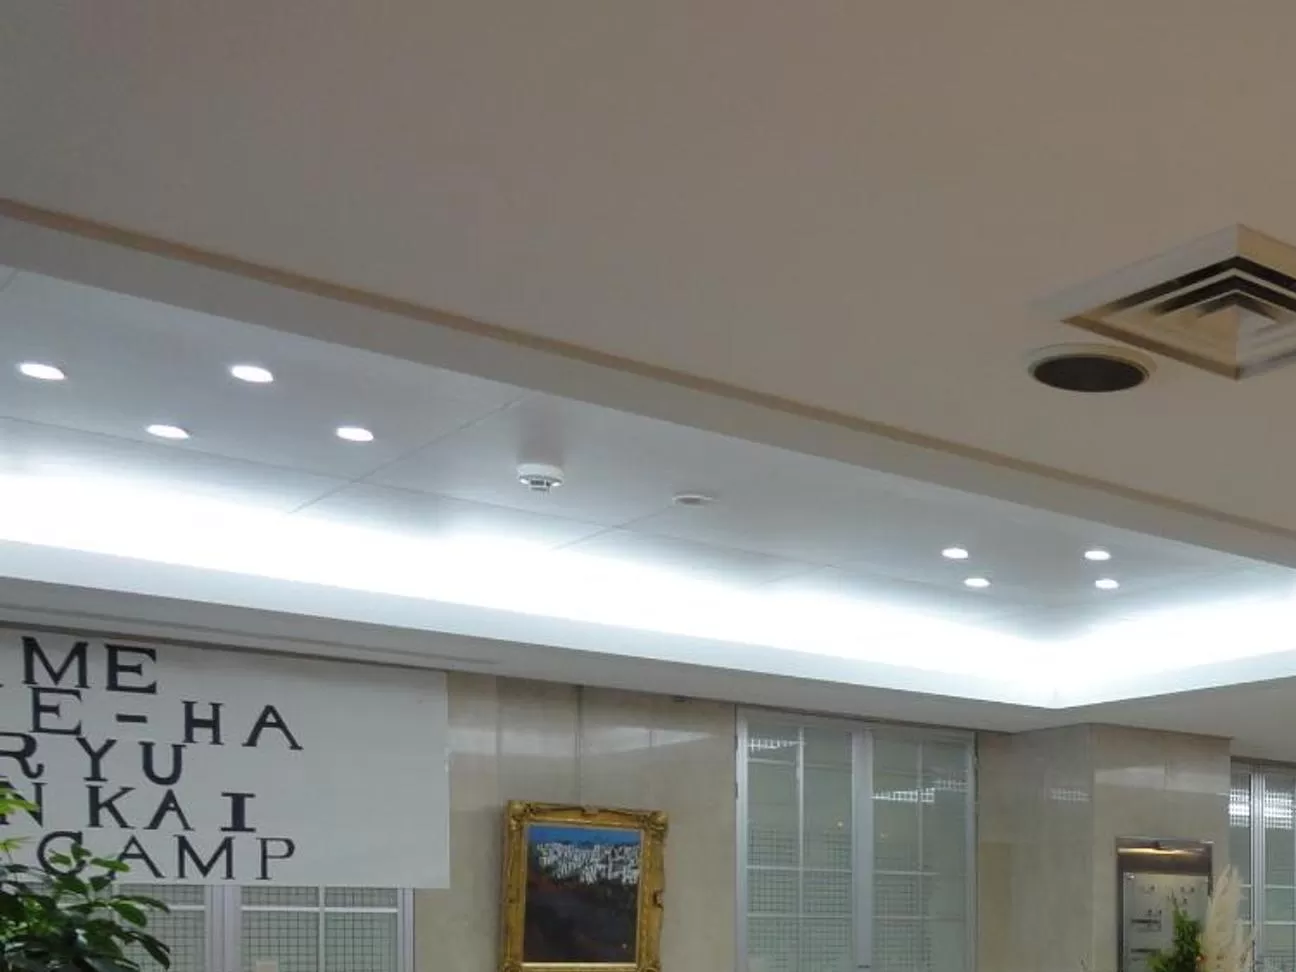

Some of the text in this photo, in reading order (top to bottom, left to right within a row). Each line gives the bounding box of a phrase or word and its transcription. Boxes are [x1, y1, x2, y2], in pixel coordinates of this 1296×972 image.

[0, 636, 157, 694] ME
[29, 687, 303, 750] E-HA
[0, 731, 186, 785] RYU
[36, 831, 296, 881] CAMP
